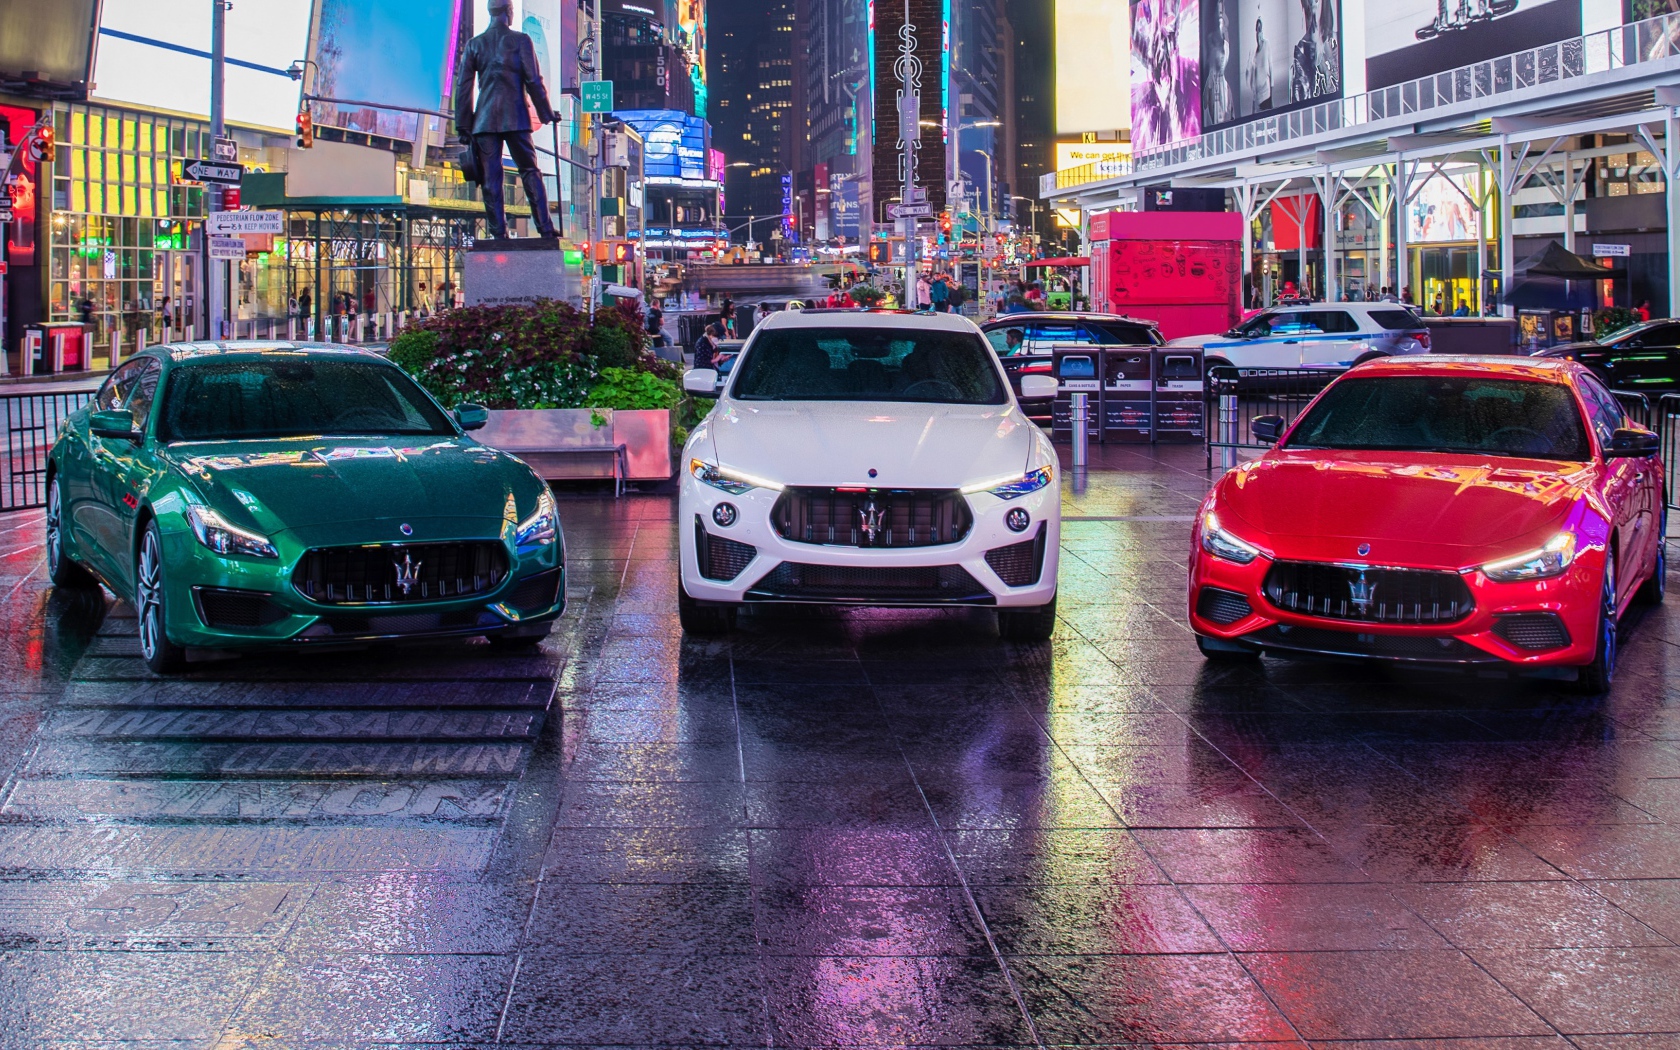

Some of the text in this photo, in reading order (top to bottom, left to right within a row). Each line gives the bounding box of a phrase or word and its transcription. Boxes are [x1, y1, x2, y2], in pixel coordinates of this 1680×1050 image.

[656, 46, 665, 86] 1500
[601, 92, 609, 100] St
[1102, 152, 1114, 161] get
[191, 166, 236, 179] ONE WAY
[893, 206, 927, 215] ONE WAY
[265, 213, 279, 221] ZONE
[244, 223, 258, 231] KEEP
